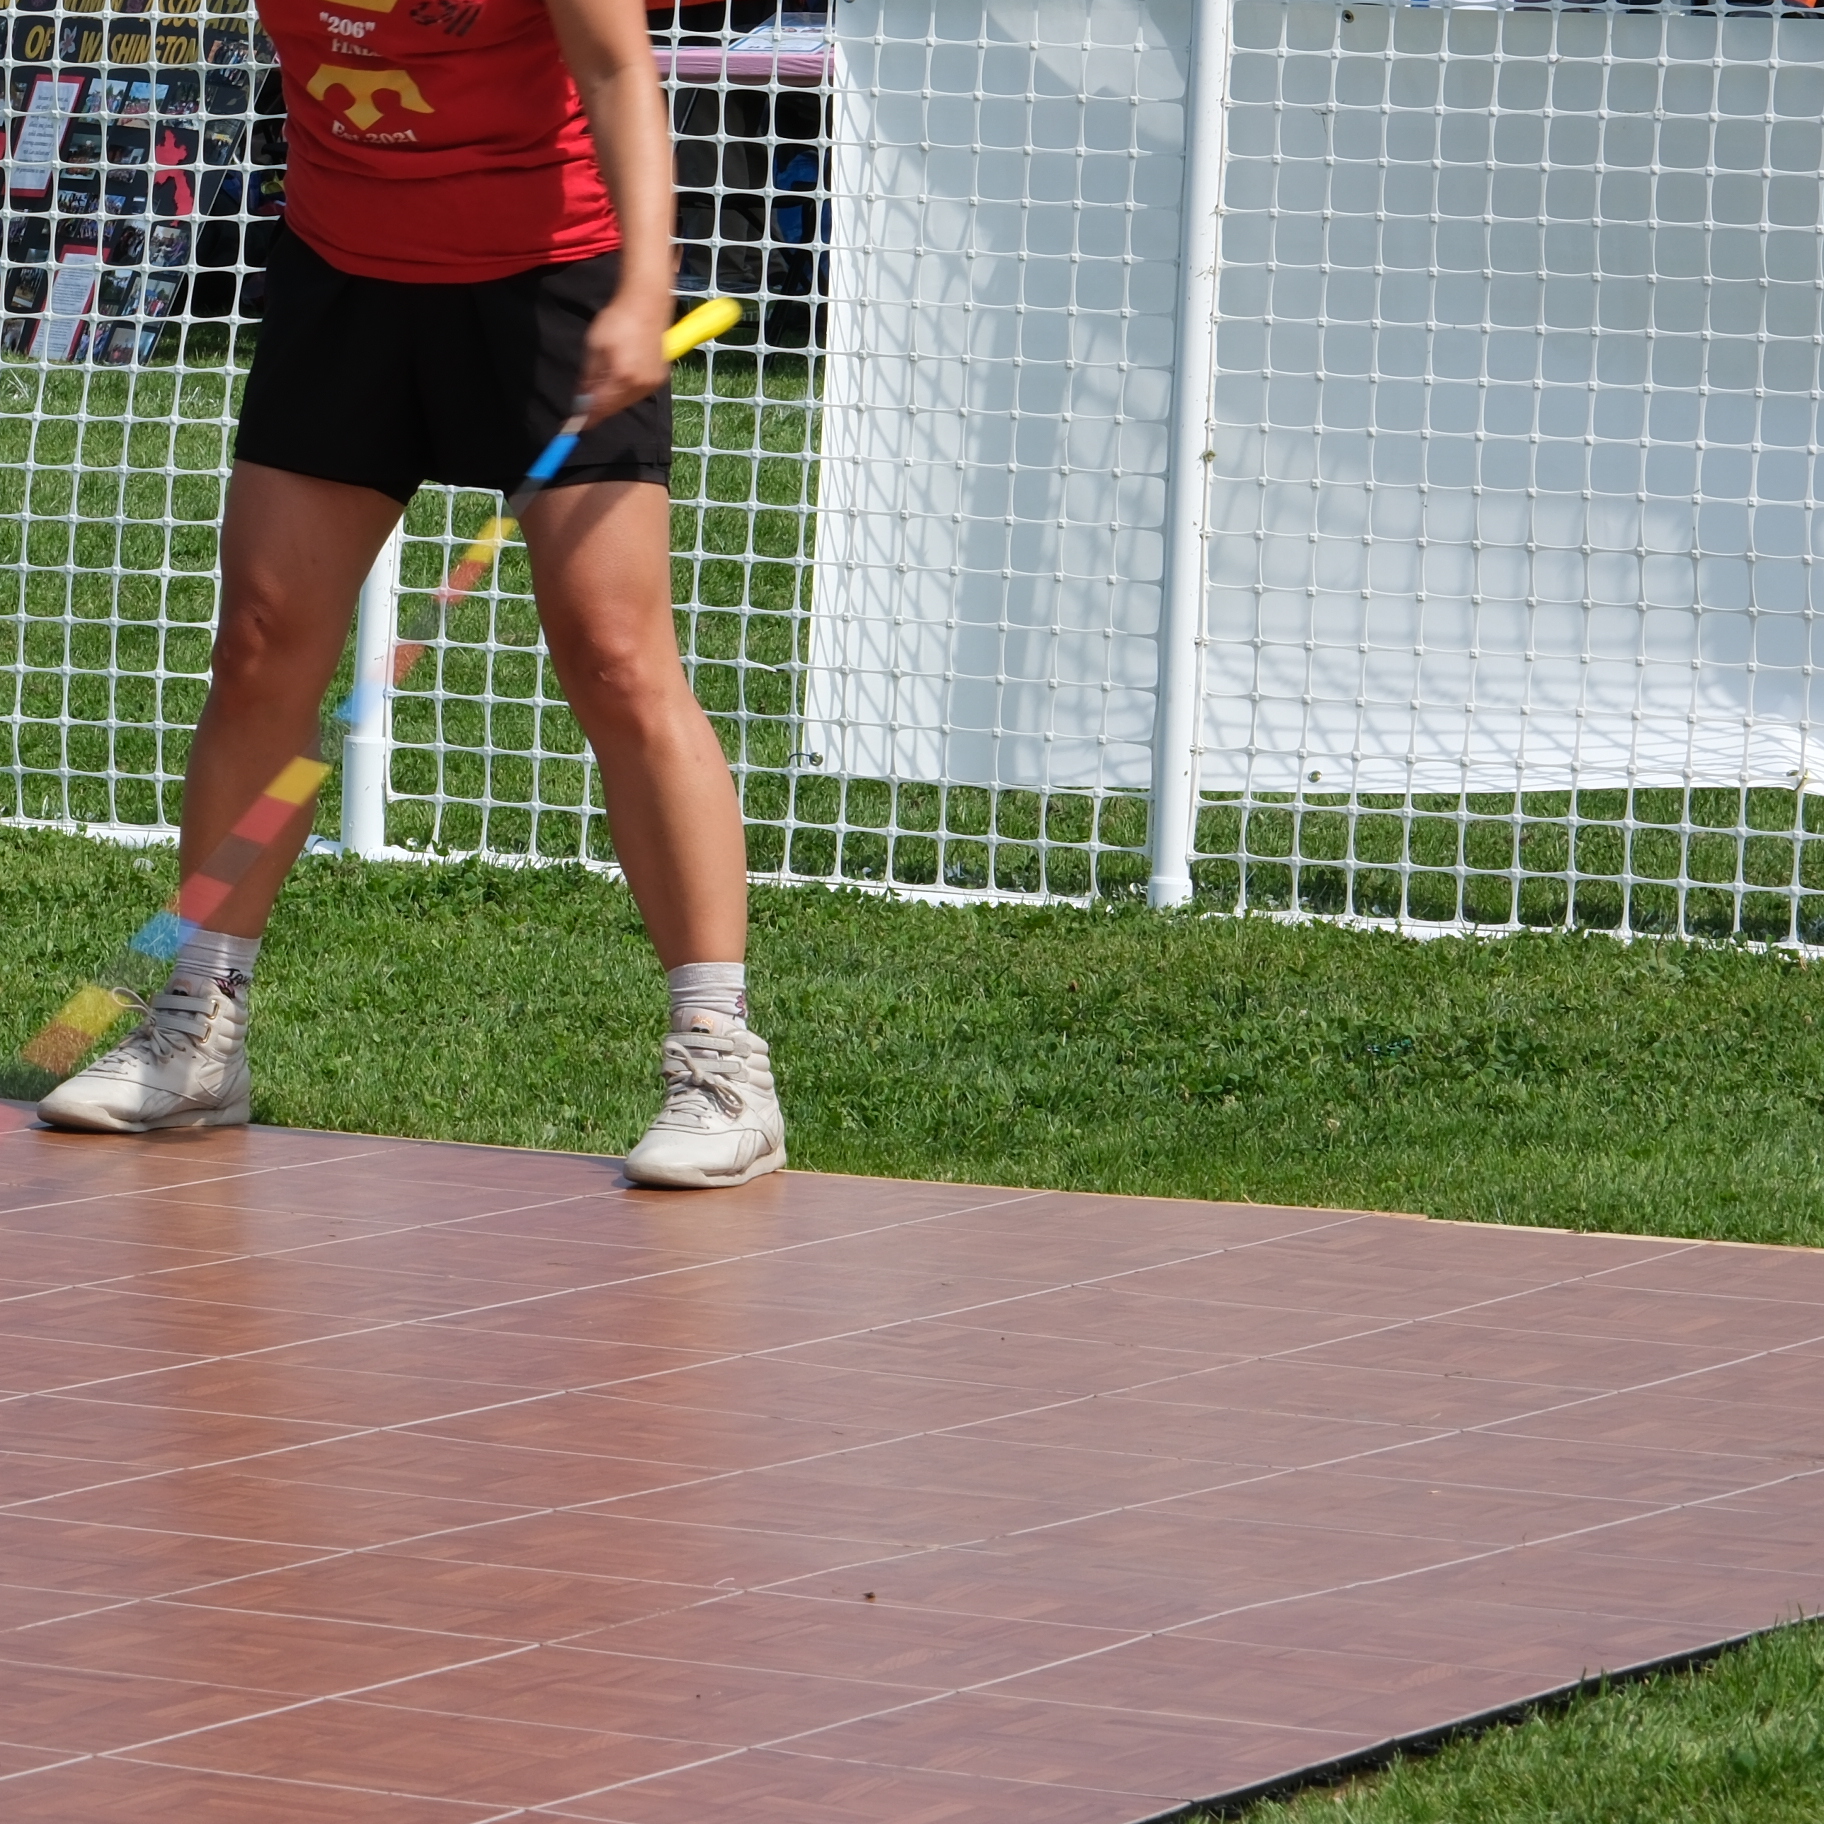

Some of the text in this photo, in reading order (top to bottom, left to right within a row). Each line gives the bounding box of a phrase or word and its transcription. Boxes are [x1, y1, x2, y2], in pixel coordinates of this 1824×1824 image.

[318, 11, 376, 38] "206"
[24, 24, 199, 72] OF WASHINGTON
